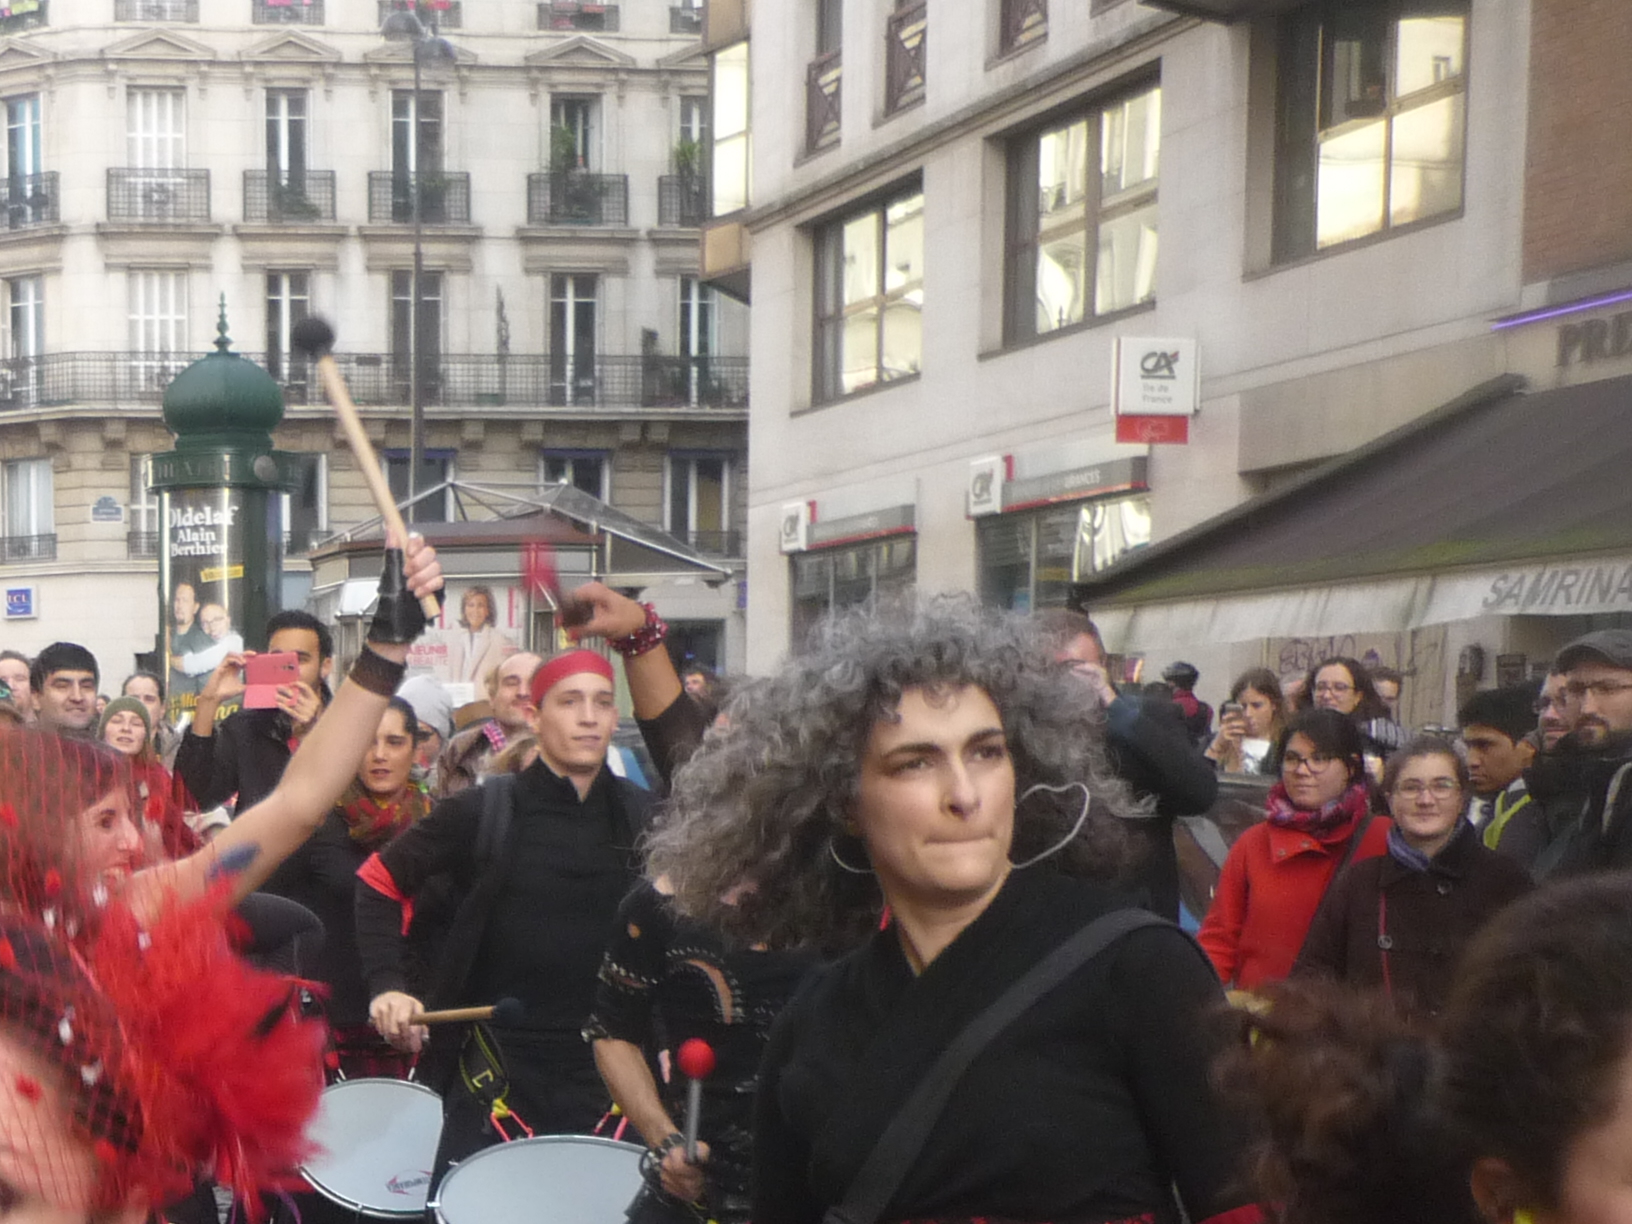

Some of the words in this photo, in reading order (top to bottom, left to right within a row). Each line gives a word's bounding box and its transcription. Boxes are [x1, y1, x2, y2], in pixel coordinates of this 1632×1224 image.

[168, 505, 238, 528] Oldelaf
[176, 527, 216, 543] Alain
[170, 542, 229, 557] Berthier
